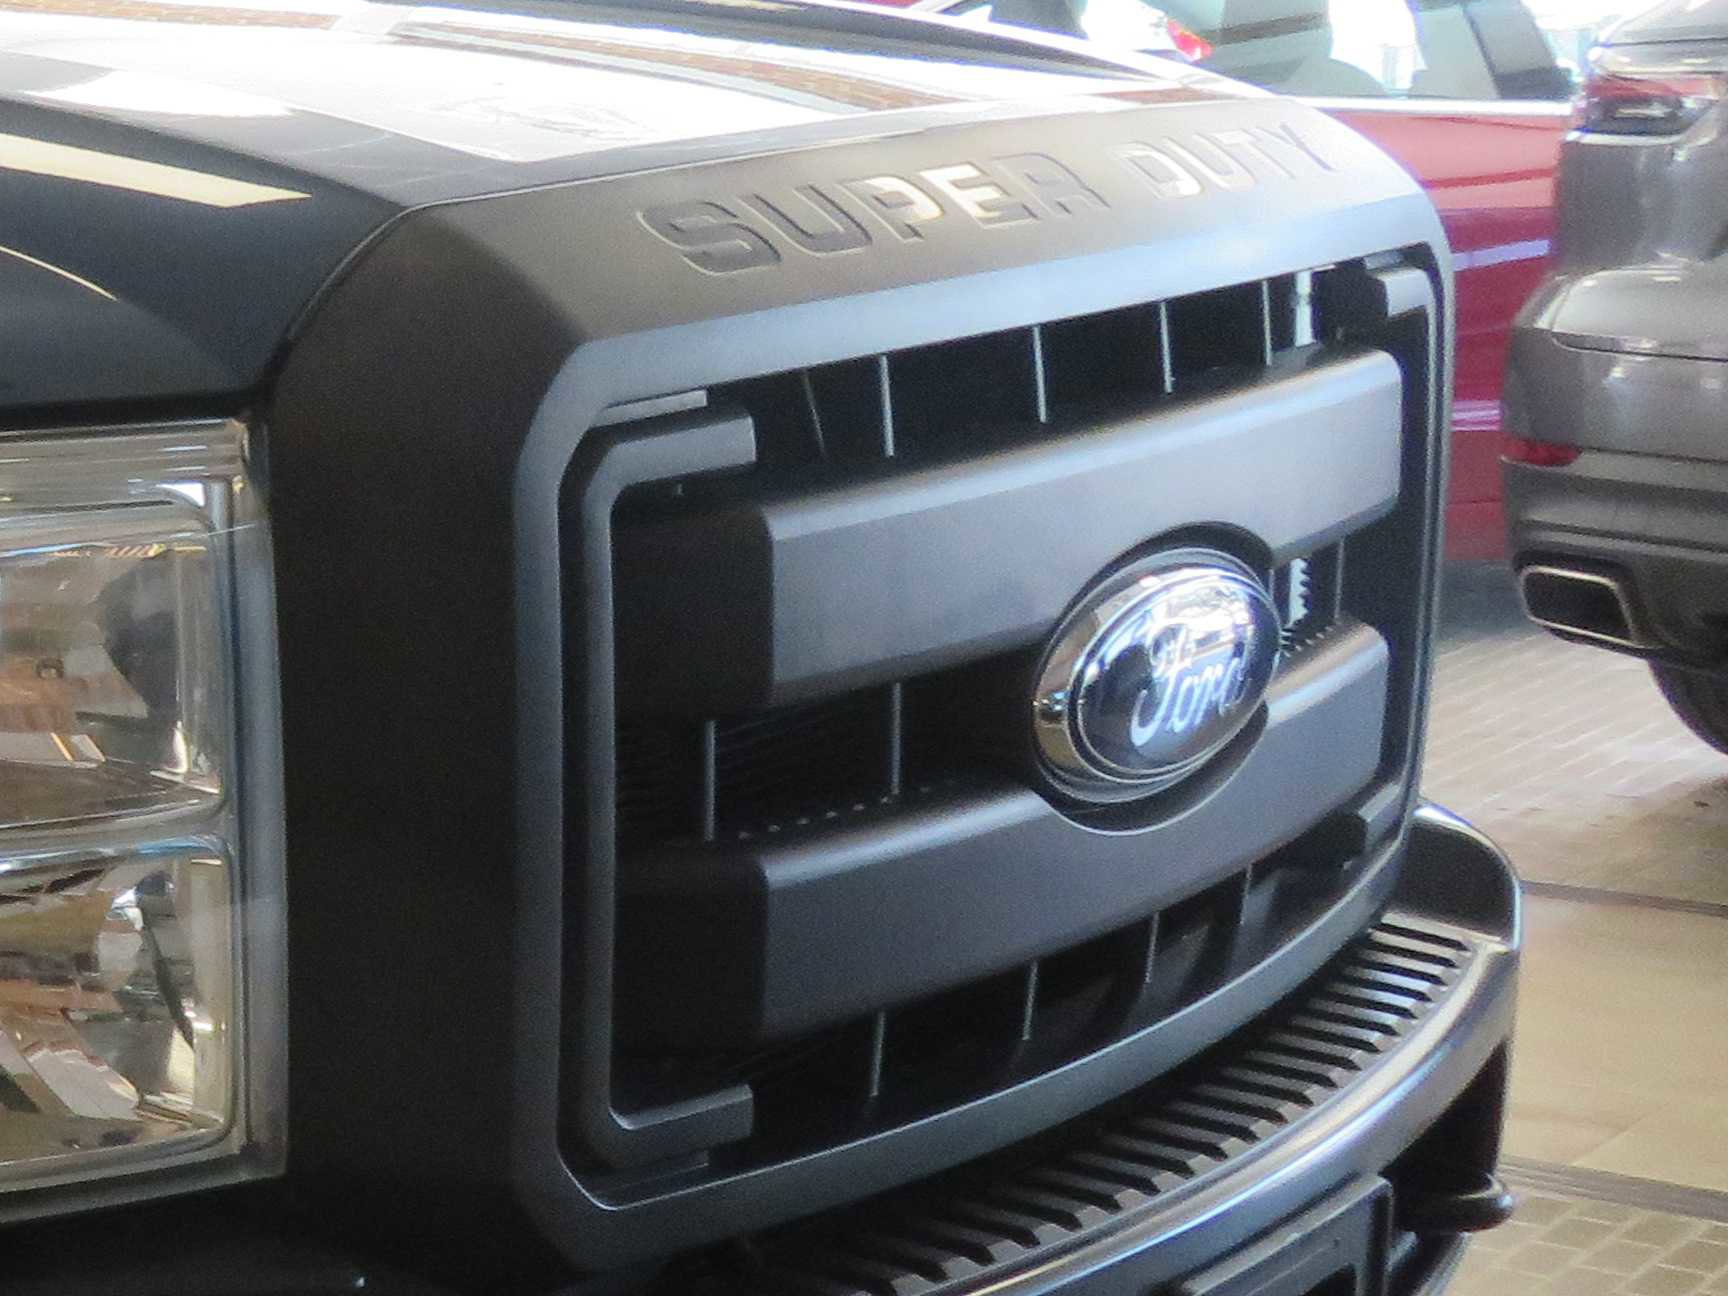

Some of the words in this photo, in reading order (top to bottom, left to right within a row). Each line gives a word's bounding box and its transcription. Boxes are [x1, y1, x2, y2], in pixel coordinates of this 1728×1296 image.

[637, 153, 1110, 275] SUPER
[1118, 123, 1337, 199] DUTY
[1131, 621, 1248, 747] Ford
